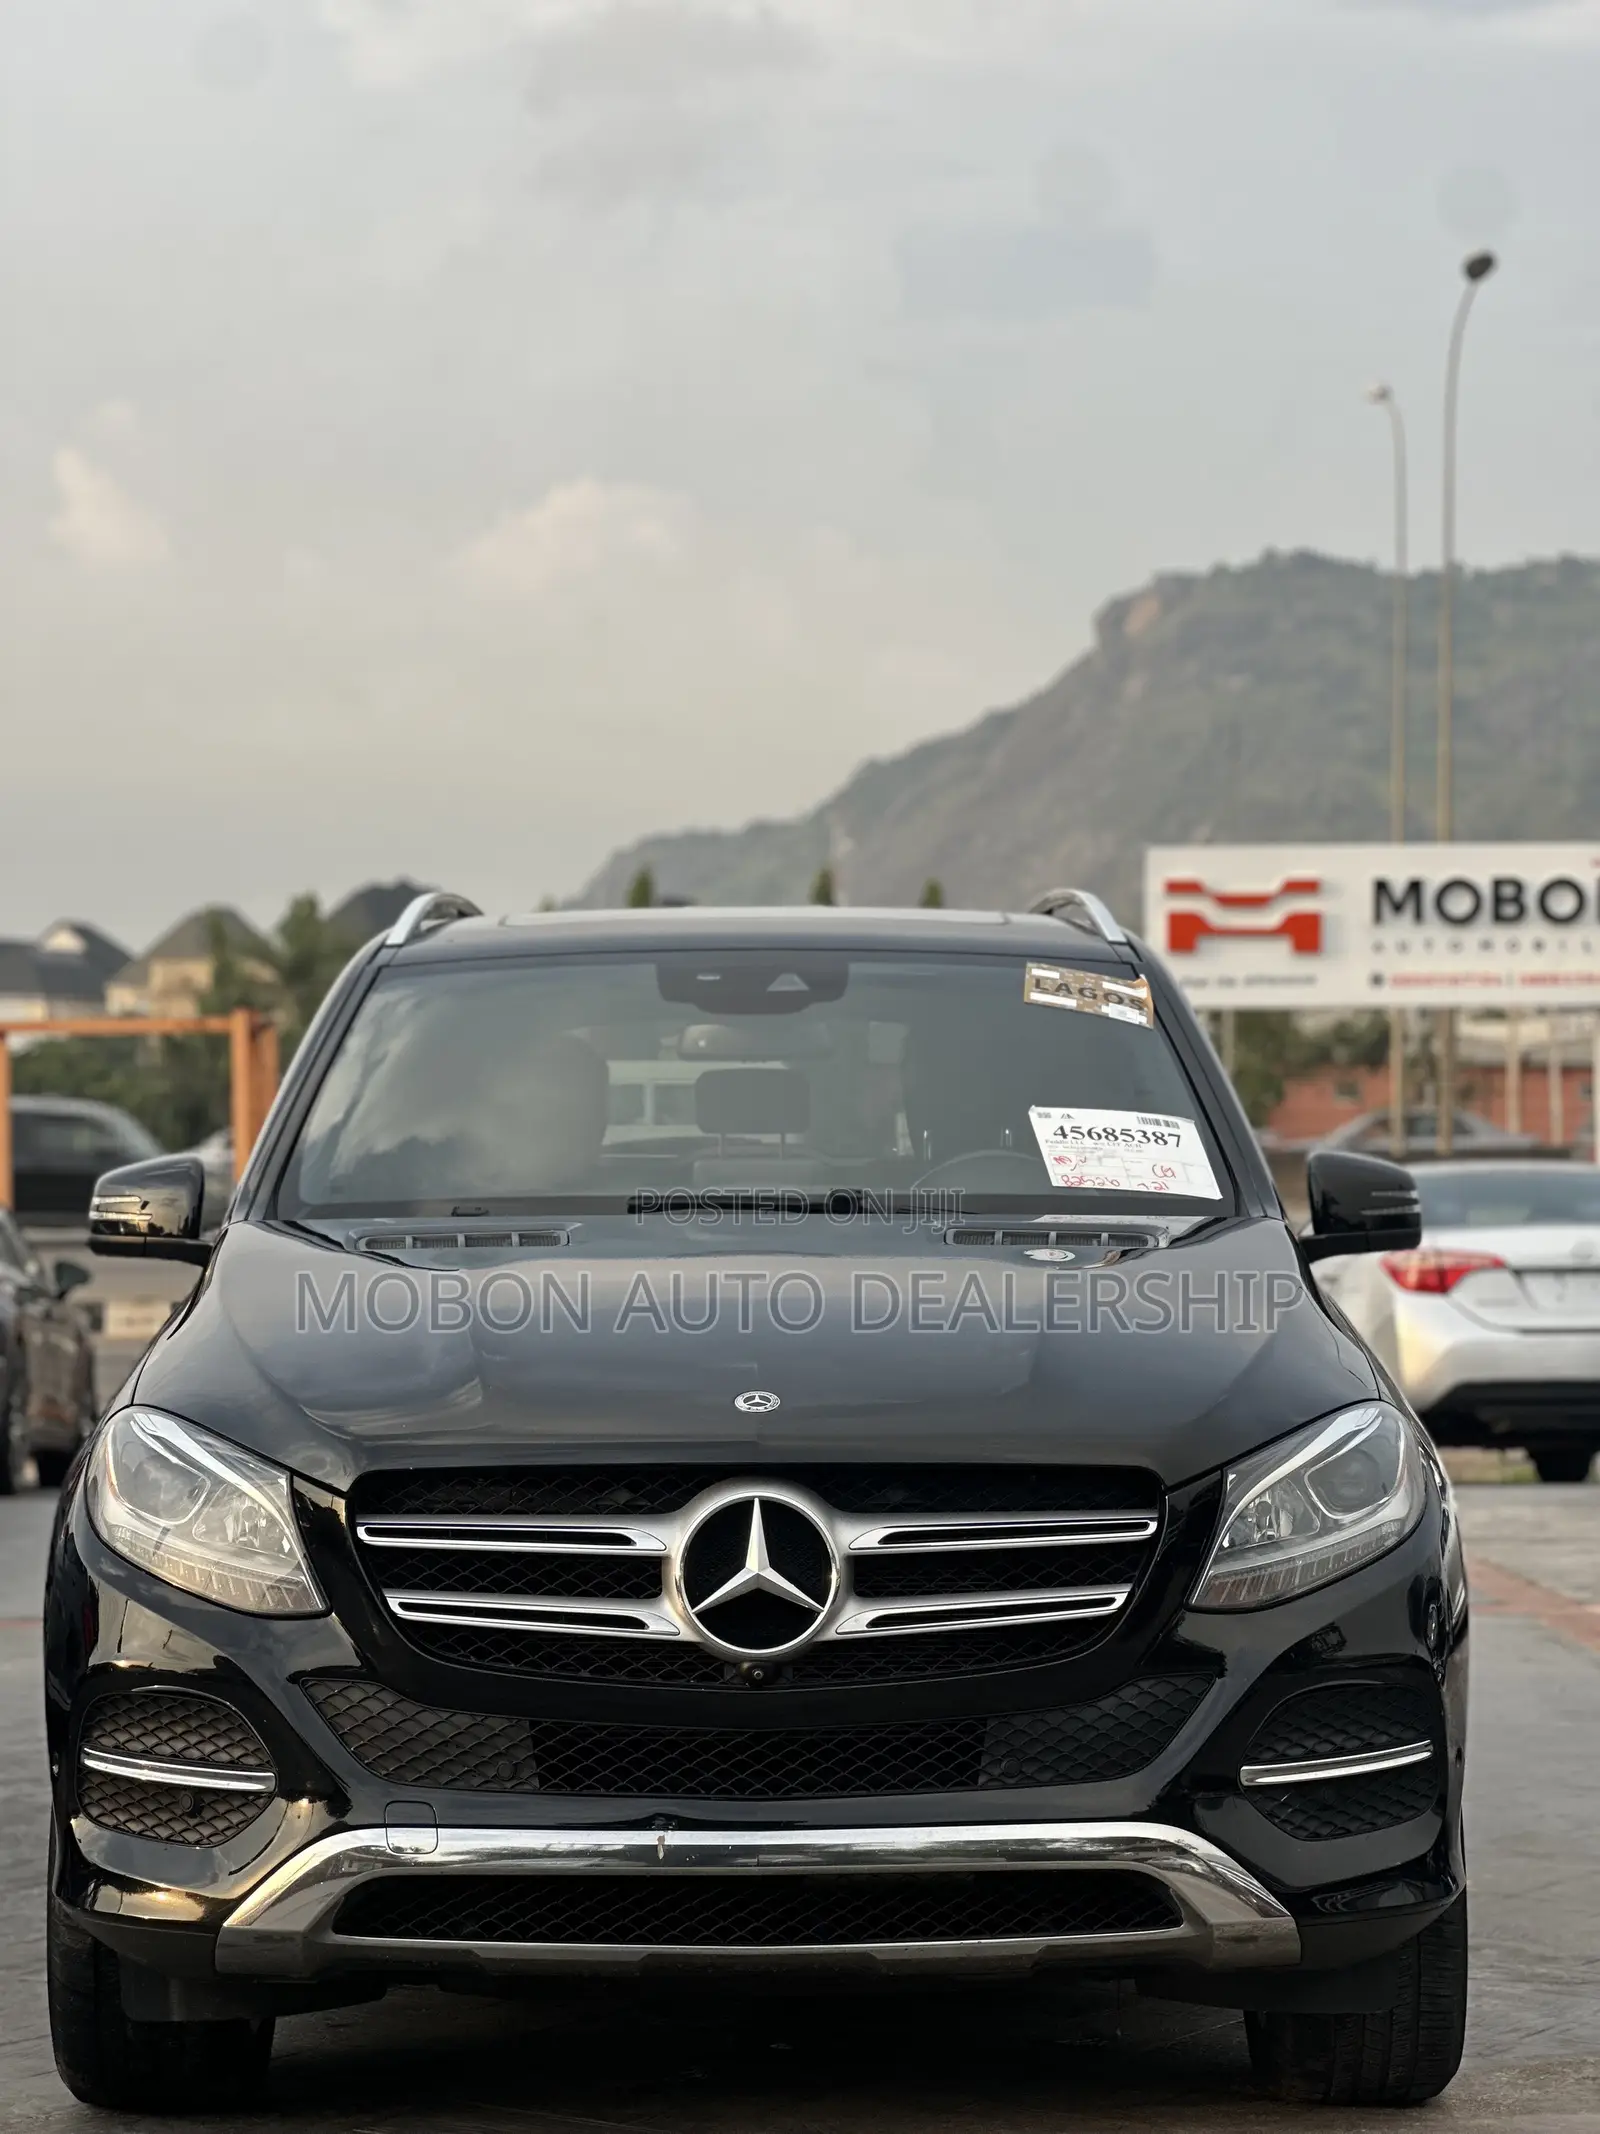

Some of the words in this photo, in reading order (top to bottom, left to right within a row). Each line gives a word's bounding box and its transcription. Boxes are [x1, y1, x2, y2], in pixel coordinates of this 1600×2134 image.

[1373, 877, 1600, 926] MOBO
[1034, 978, 1145, 1011] LAGOS
[1053, 1125, 1181, 1148] 45685387
